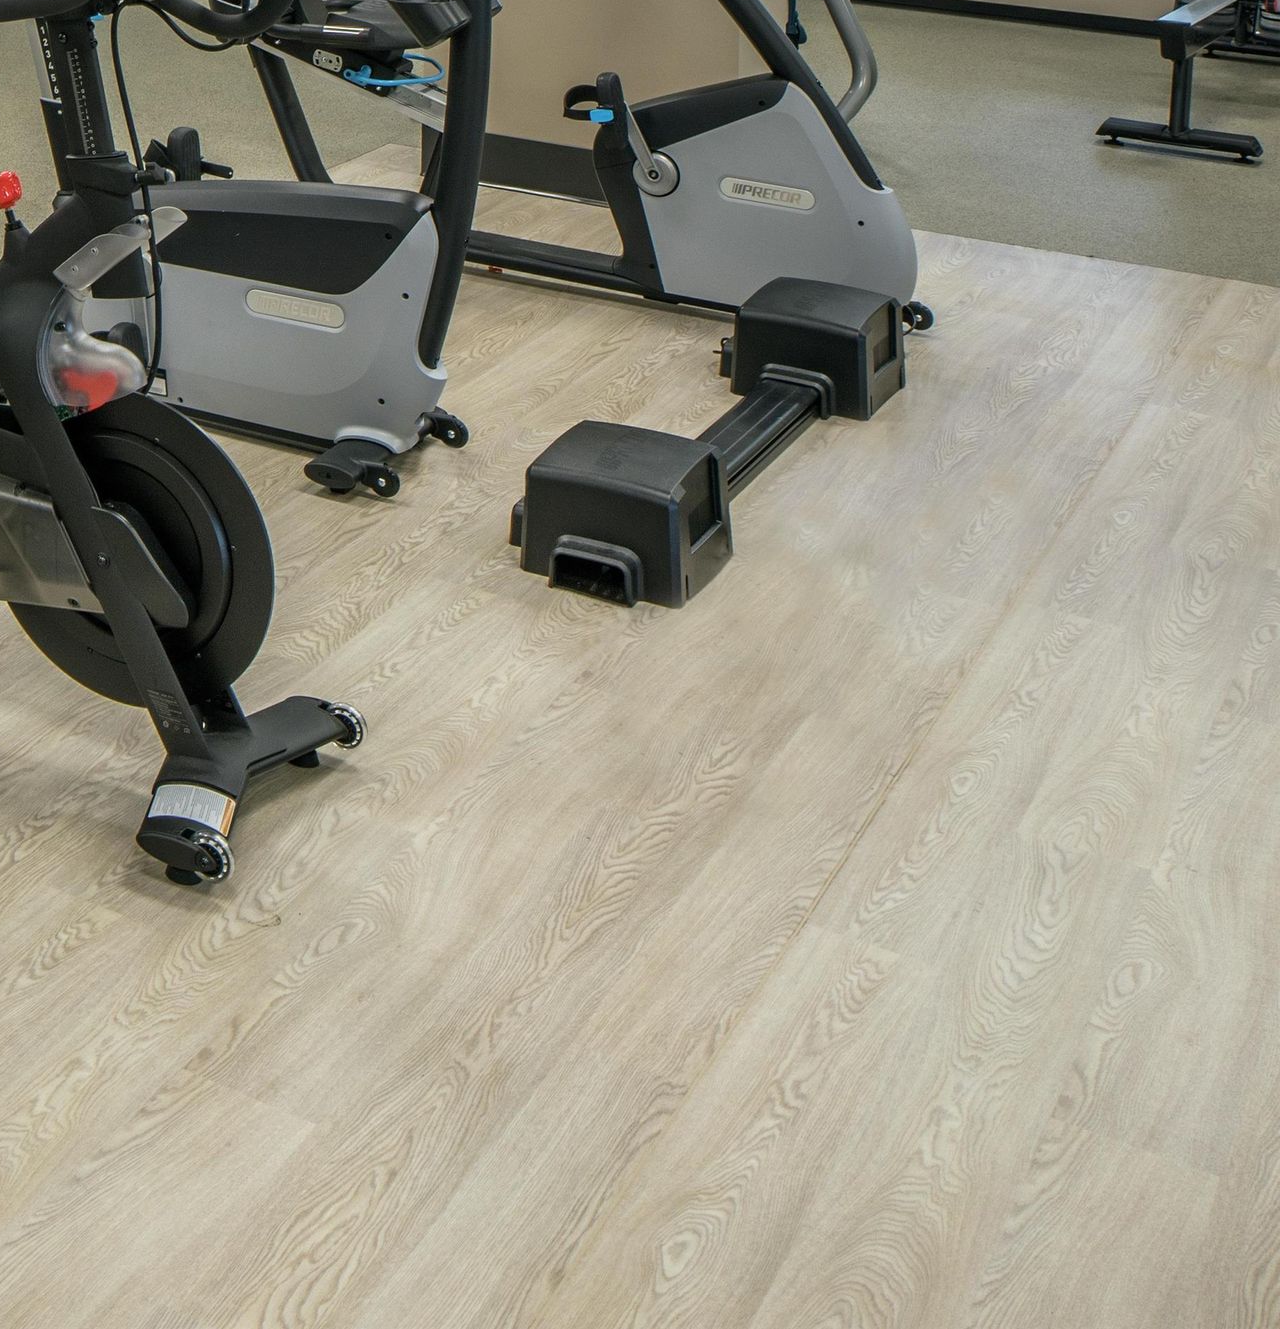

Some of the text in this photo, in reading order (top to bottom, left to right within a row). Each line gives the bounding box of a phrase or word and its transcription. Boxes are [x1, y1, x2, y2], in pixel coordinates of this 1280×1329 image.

[40, 26, 46, 34] 1
[42, 38, 49, 47] 2
[45, 50, 51, 58] 3
[48, 62, 54, 70] 4
[50, 74, 56, 82] 5
[54, 86, 59, 94] 6
[742, 184, 801, 204] PRECOR
